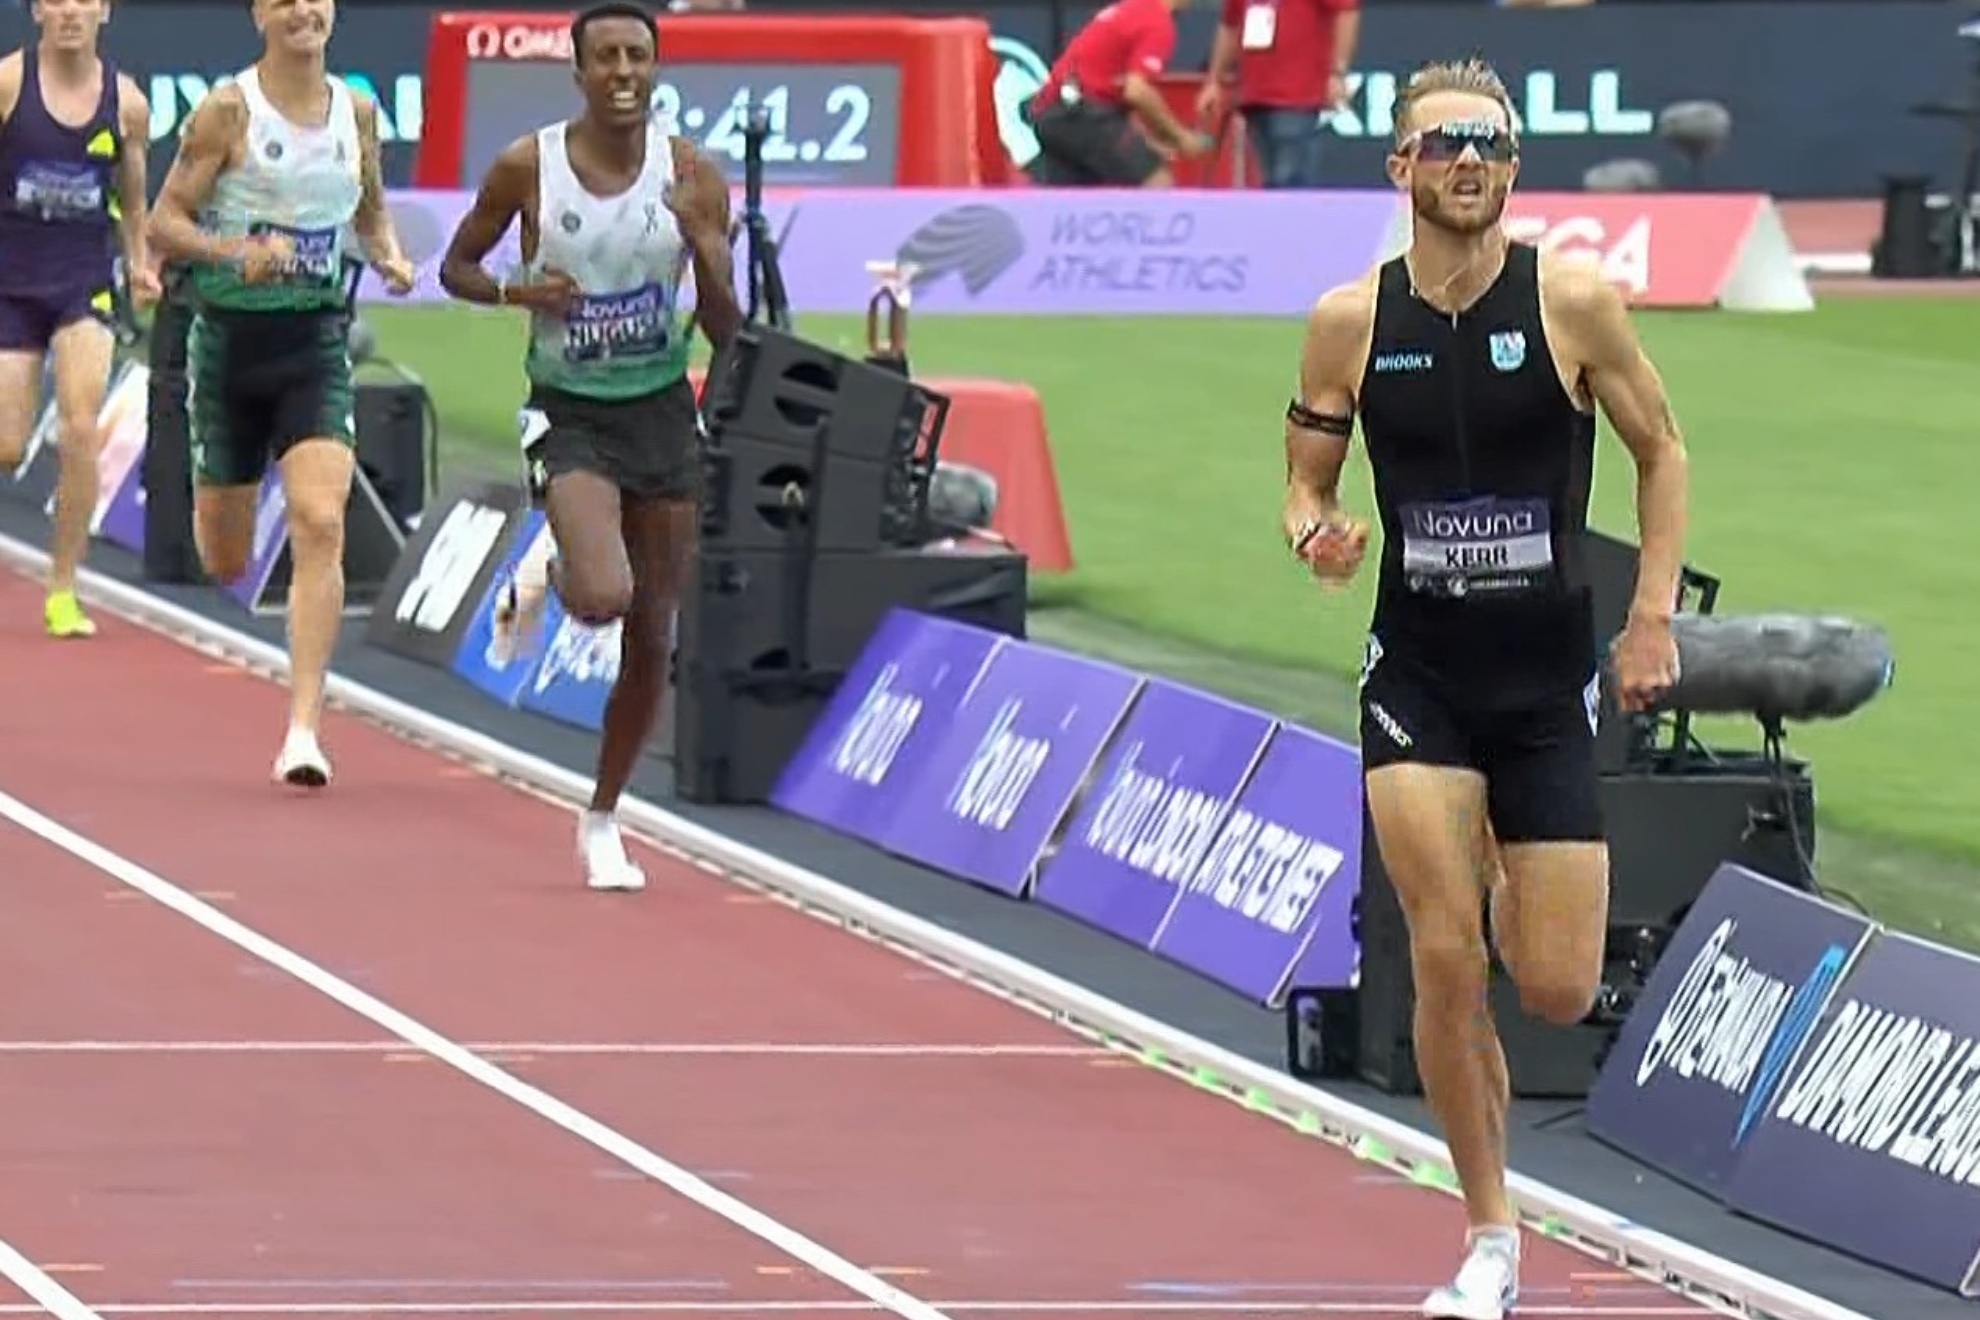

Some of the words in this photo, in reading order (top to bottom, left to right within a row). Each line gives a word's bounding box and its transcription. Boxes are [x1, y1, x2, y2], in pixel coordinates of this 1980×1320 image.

[1051, 211, 1195, 245] WORLD
[1026, 255, 1249, 293] ATHLETICS
[1375, 353, 1434, 372] BROOKS
[1413, 510, 1533, 538] Novuna
[1446, 544, 1508, 568] KERR
[1776, 999, 1952, 1151] DIAMOND
